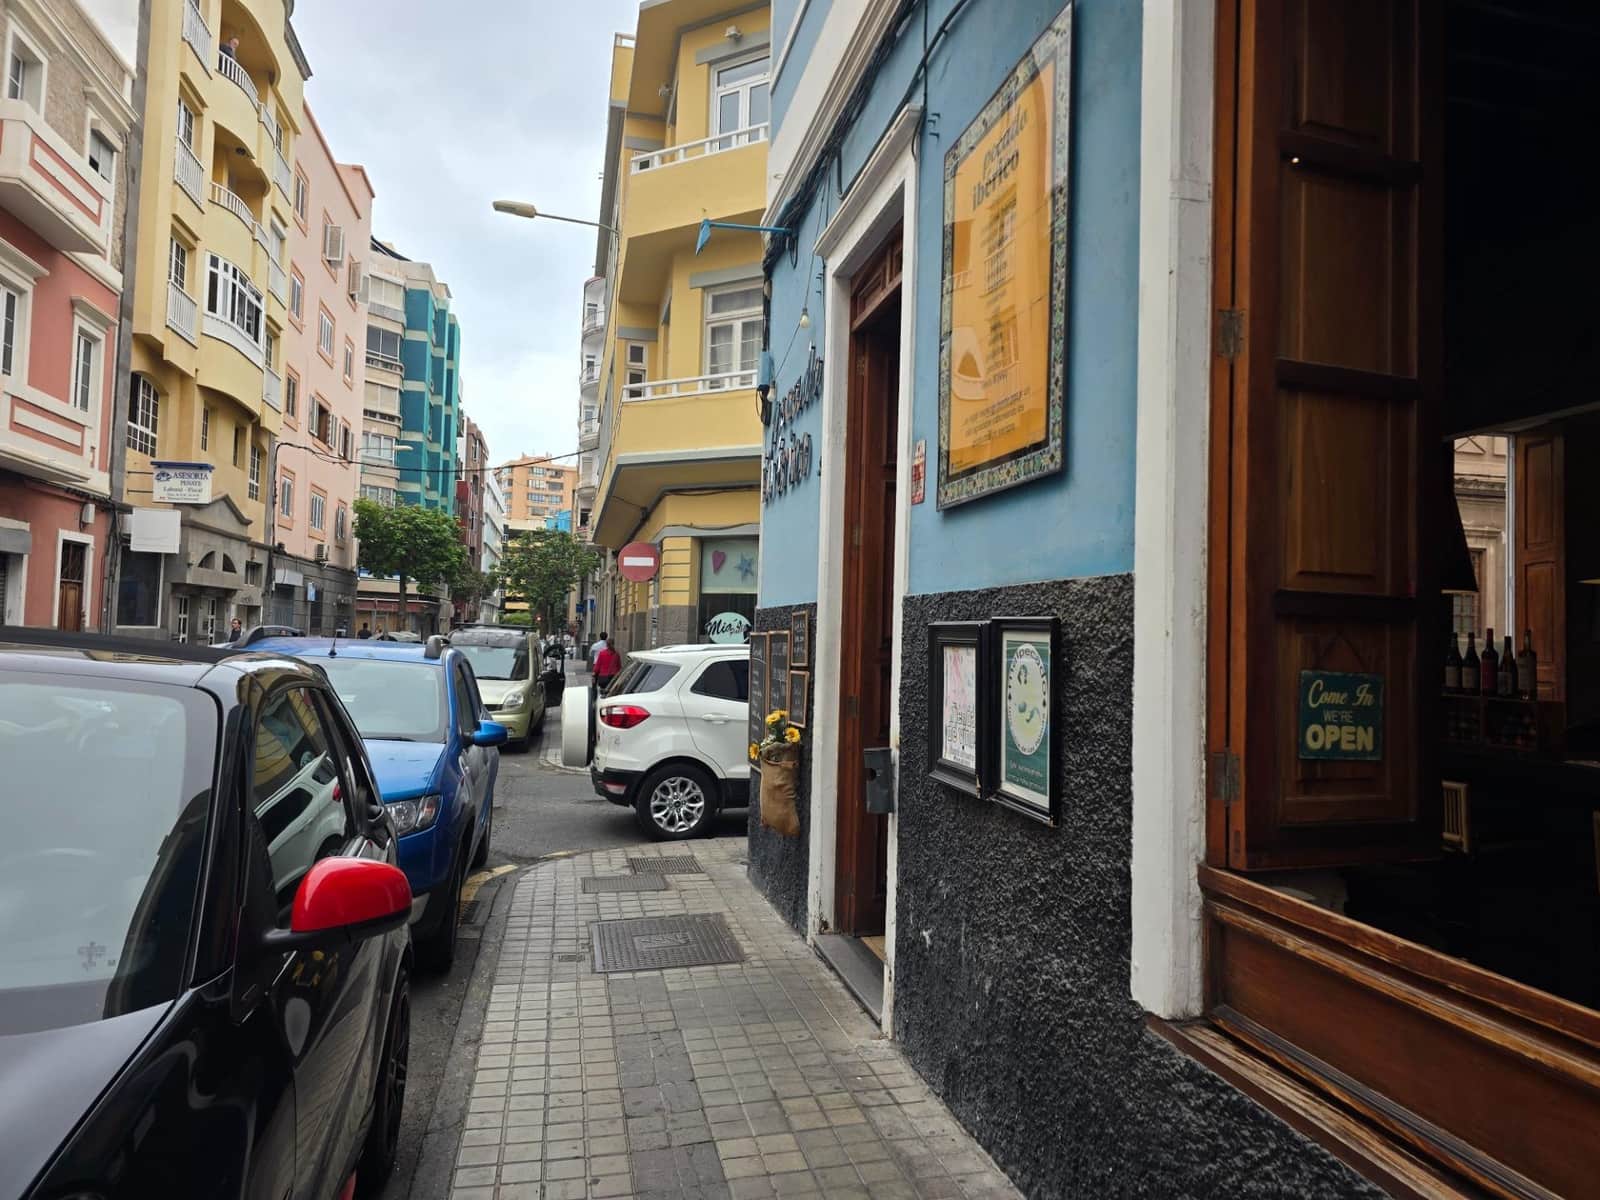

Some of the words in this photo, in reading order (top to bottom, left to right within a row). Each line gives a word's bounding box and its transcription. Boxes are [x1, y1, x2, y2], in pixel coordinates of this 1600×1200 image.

[1308, 679, 1347, 709] Come
[1352, 683, 1376, 707] In
[1322, 710, 1353, 722] WE'RE
[1305, 725, 1373, 751] OPEN
